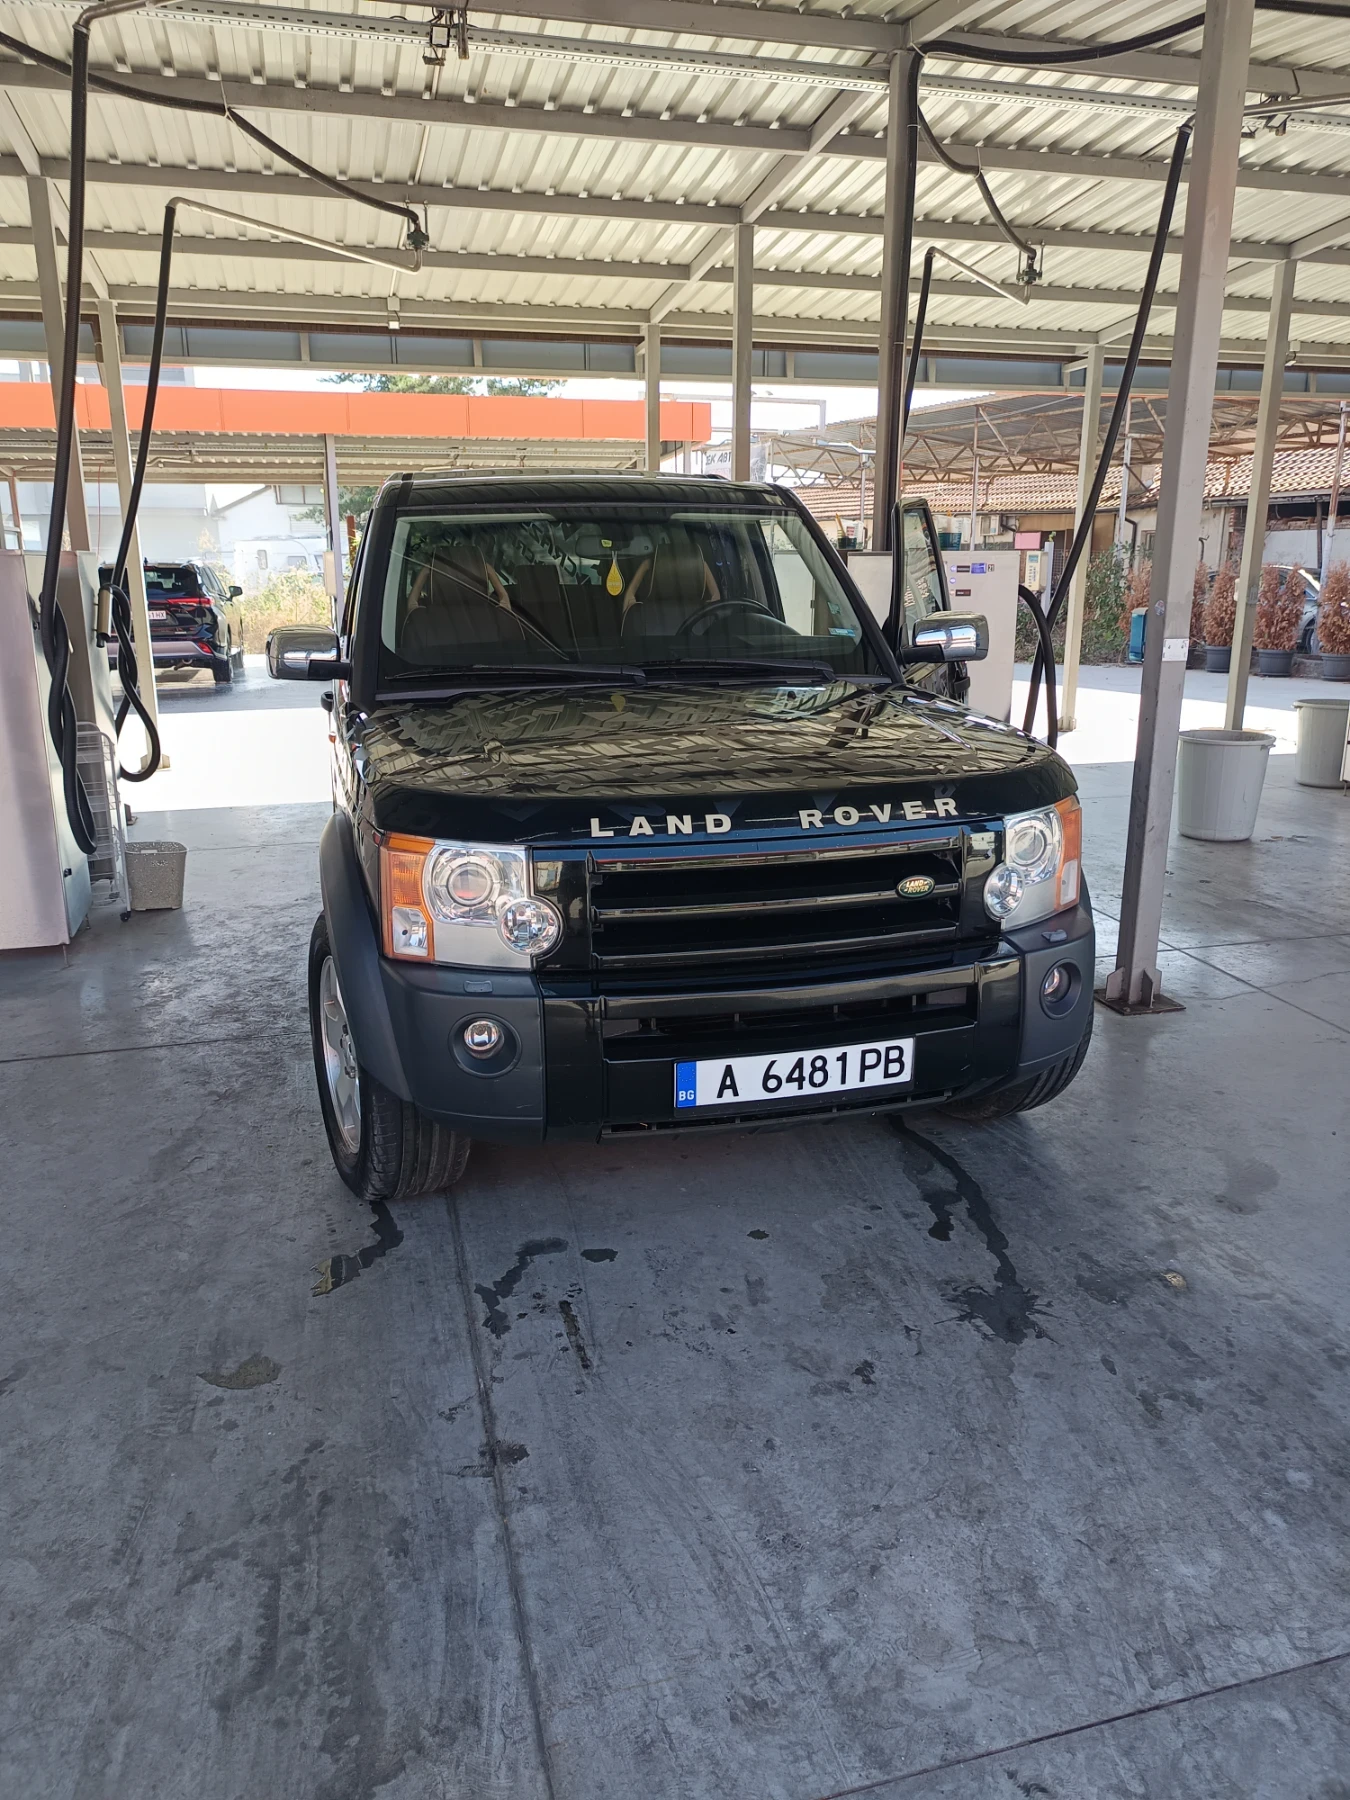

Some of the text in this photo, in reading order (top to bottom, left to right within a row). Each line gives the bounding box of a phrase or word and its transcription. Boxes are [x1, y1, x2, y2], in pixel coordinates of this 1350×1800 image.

[590, 798, 959, 838] LAND ROVER
[906, 880, 924, 888] LAND
[716, 1064, 740, 1098] A
[678, 1090, 695, 1101] BG
